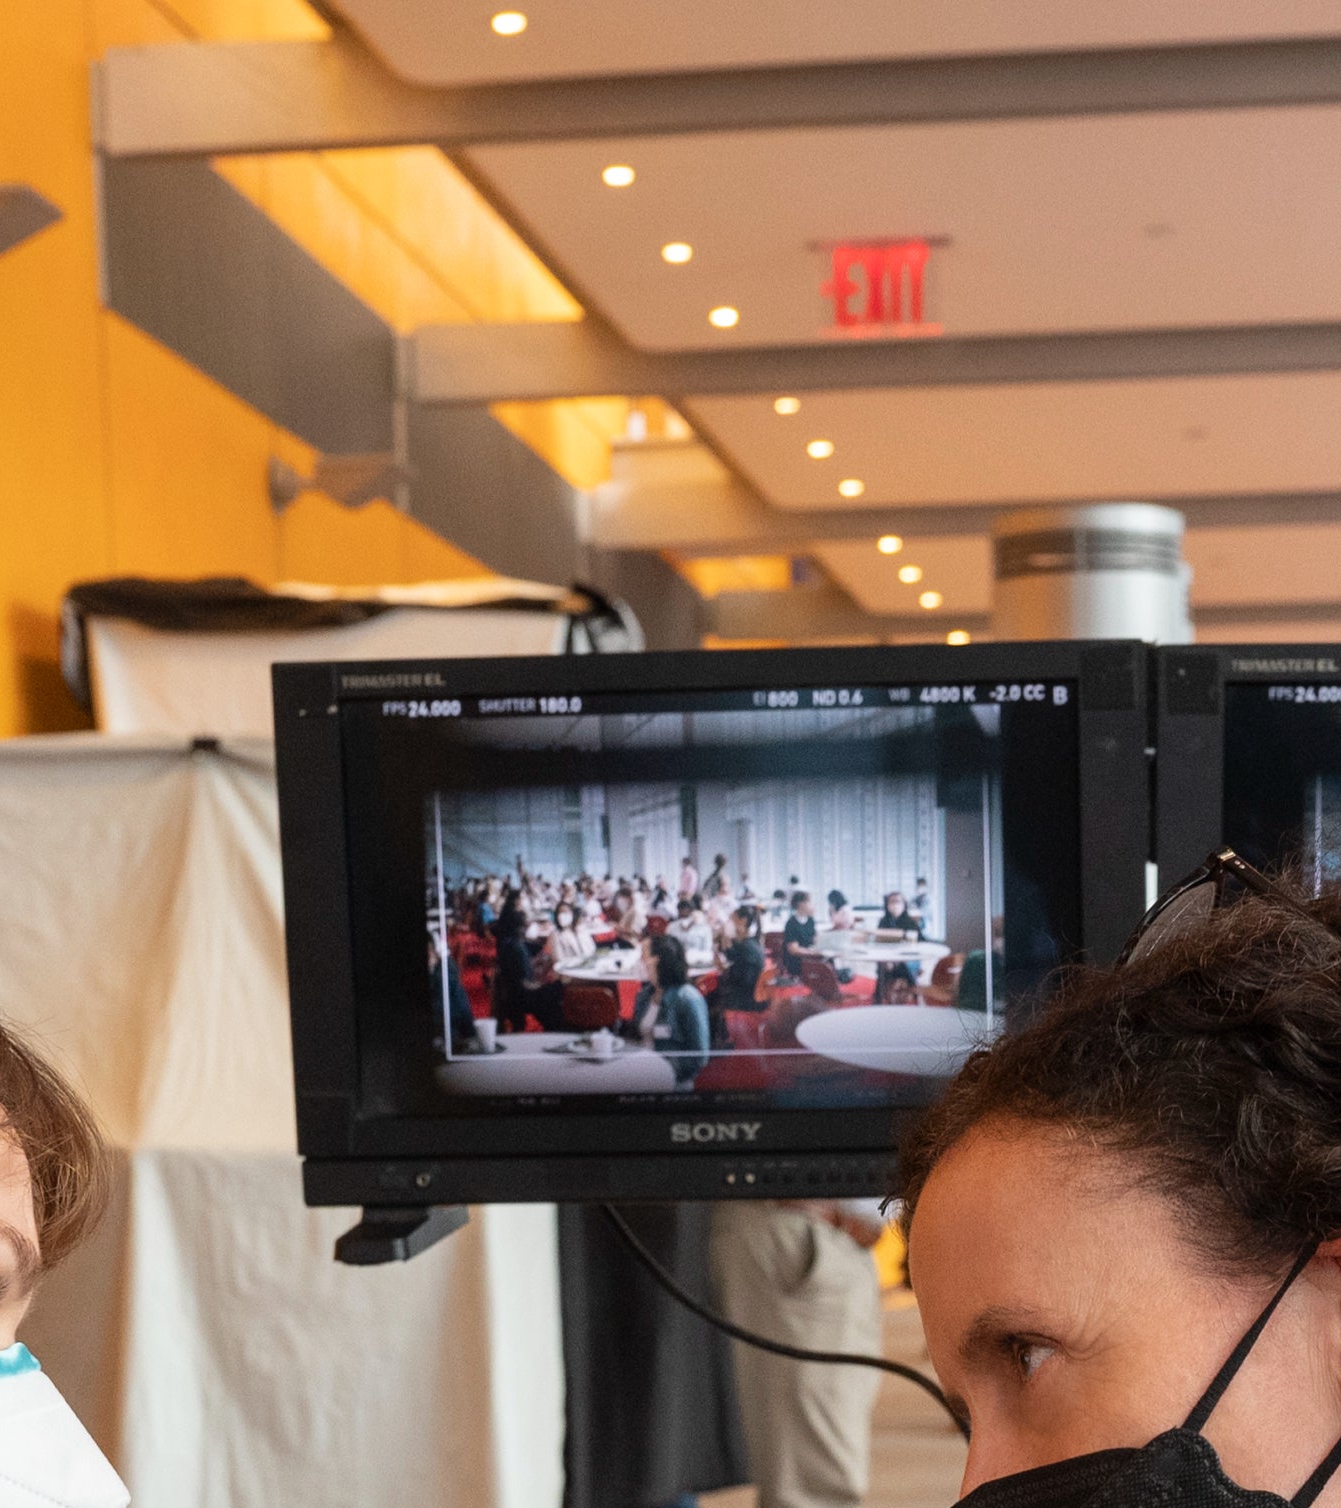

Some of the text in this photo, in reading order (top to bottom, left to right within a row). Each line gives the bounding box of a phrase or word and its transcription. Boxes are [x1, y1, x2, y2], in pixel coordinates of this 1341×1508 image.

[1316, 658, 1340, 673] EL
[424, 672, 446, 687] EL
[382, 700, 407, 716] FPS
[408, 699, 462, 718] 24.000
[478, 697, 537, 714] SHUTTER
[539, 695, 583, 714] 180.0
[767, 690, 799, 707] 800
[812, 689, 837, 706] ND
[838, 688, 864, 705] 0.6
[919, 686, 960, 703] 4800
[962, 685, 977, 702] K
[988, 683, 1021, 701] -2.0
[1023, 683, 1046, 701] CC
[1052, 685, 1069, 706] B
[1267, 685, 1294, 701] FPS
[670, 1121, 763, 1143] SONY
